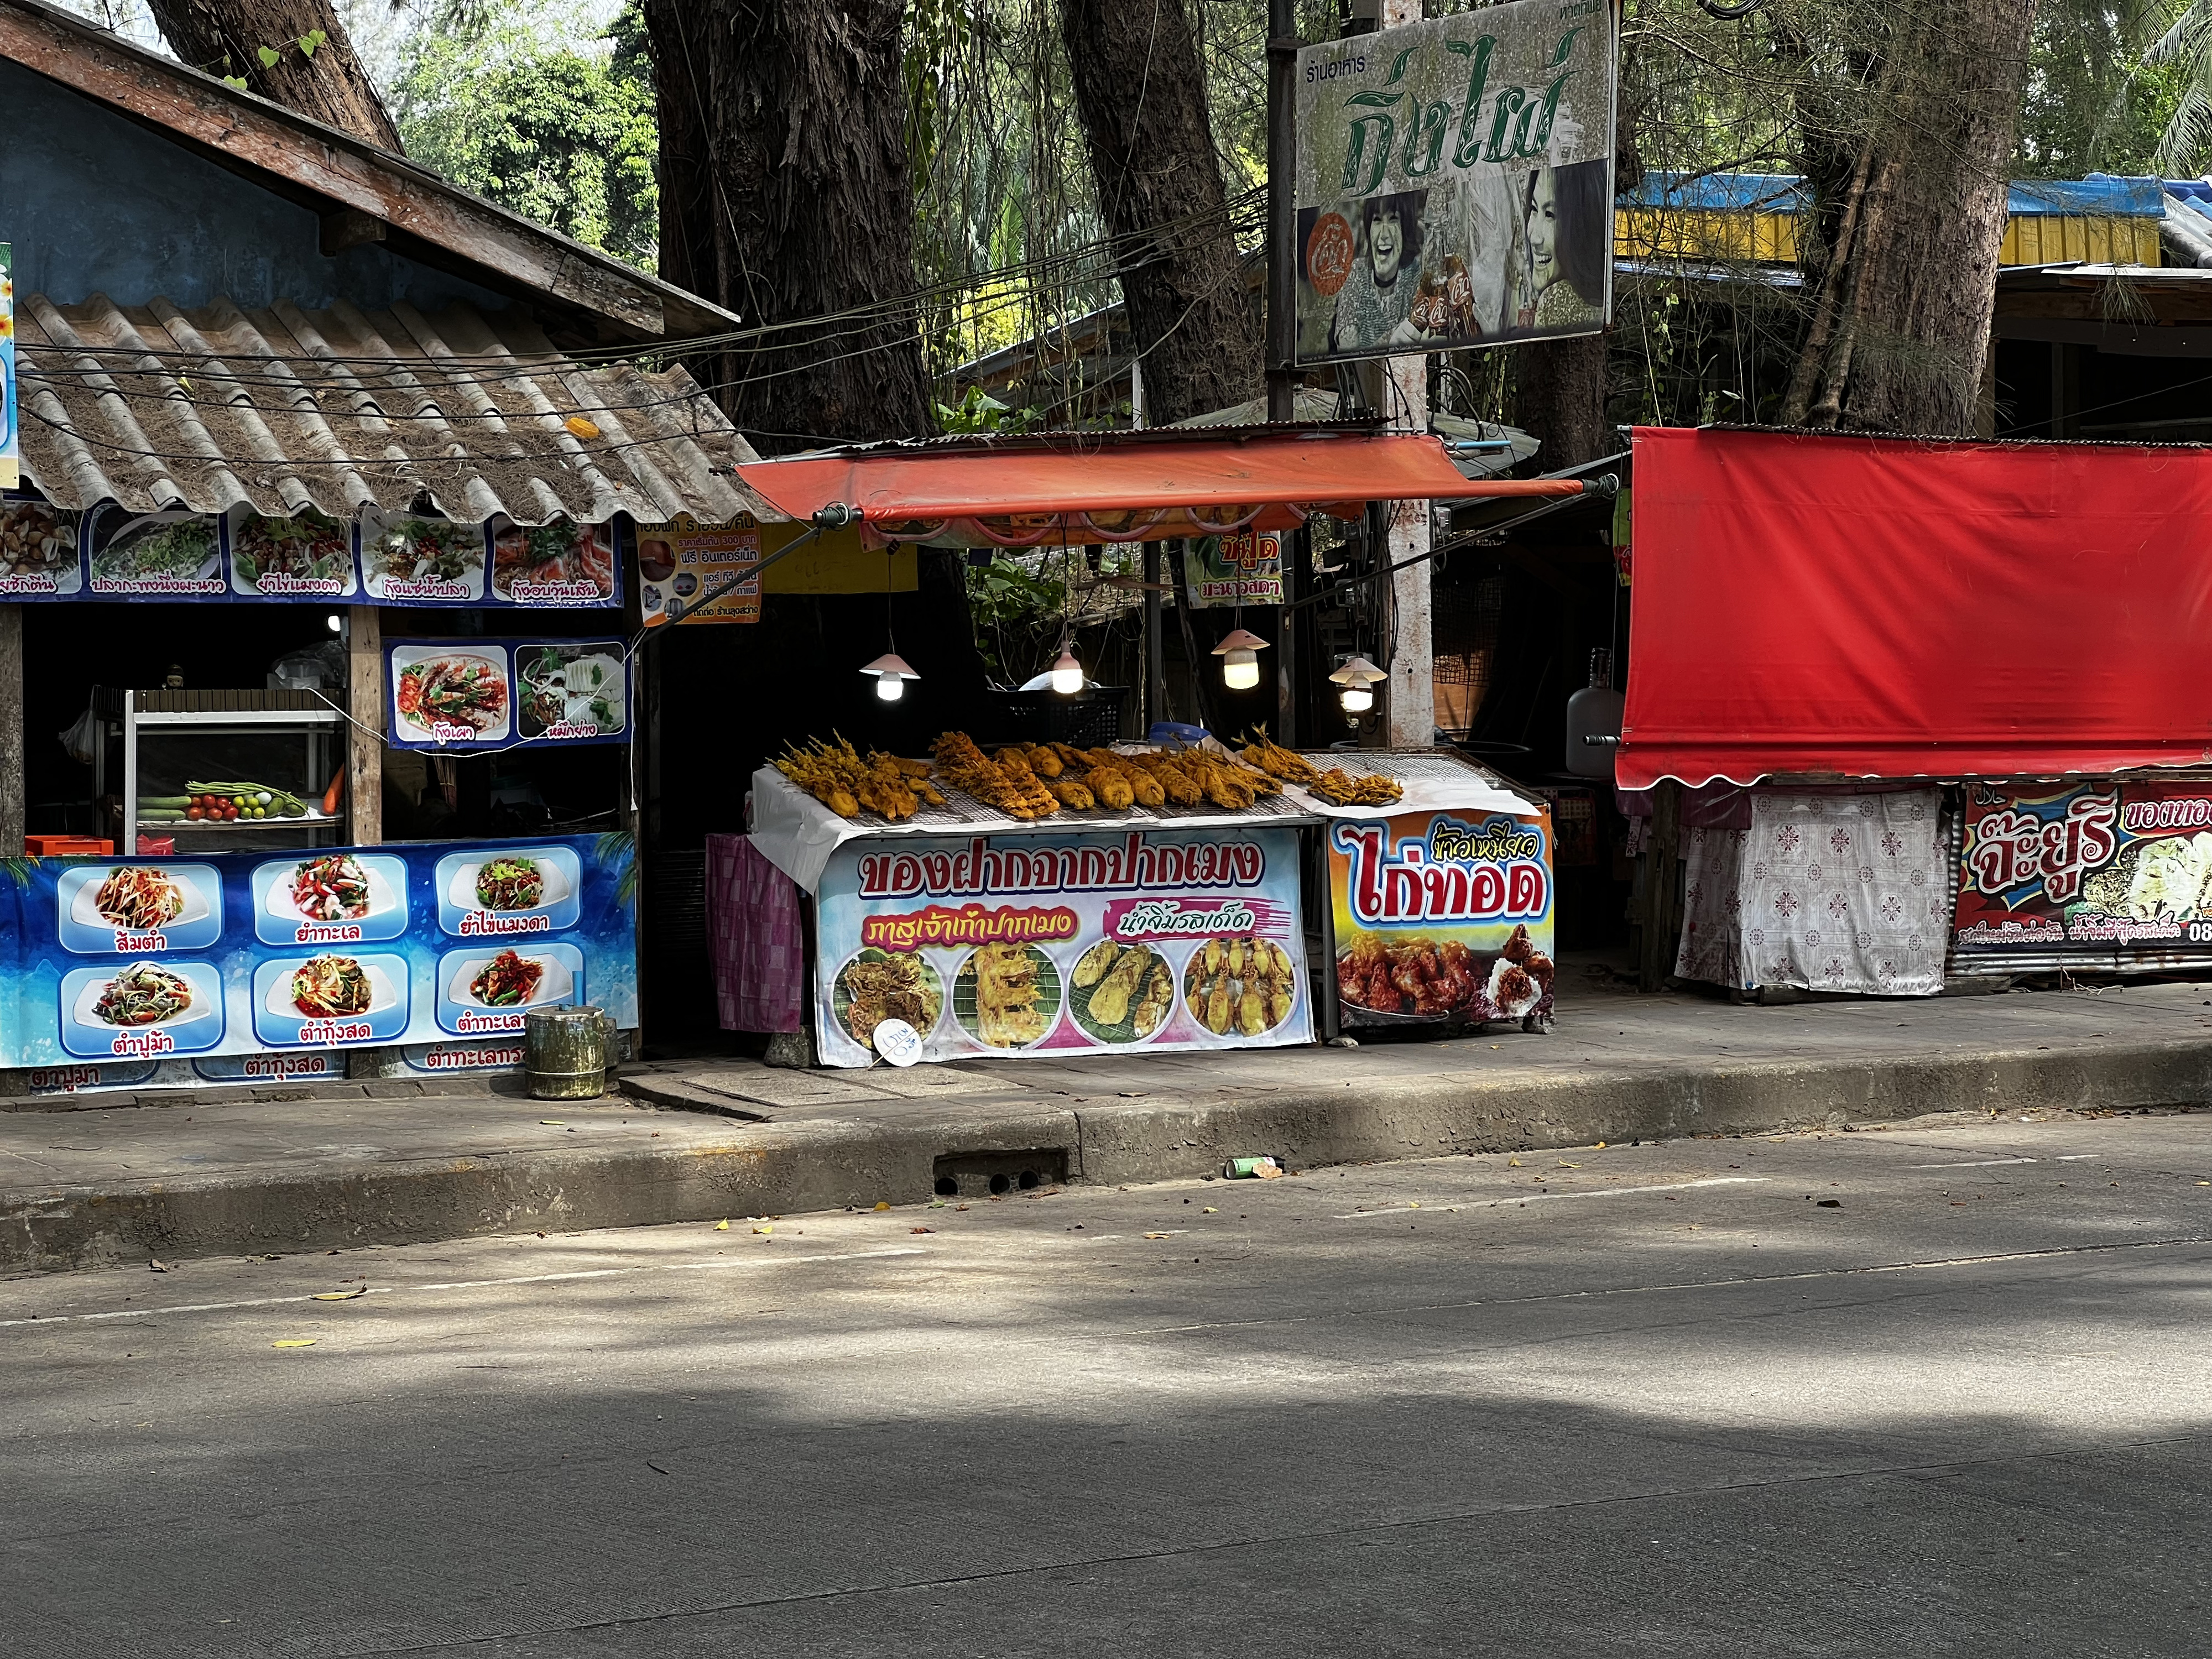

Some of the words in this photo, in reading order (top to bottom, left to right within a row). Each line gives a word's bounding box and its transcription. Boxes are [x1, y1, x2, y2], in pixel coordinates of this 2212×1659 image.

[1306, 55, 1365, 84] ร้านอาหาร
[679, 535, 719, 546] ราคาเริ่มต้น
[722, 536, 738, 545] 300
[742, 535, 756, 543] บาท
[681, 551, 697, 563] ฟรี
[701, 547, 757, 562] อินเตอร์เน็ต
[92, 571, 224, 591] ปลากะพงนึ่งมะนาว
[258, 574, 339, 591] ยำไข่แมงดา
[704, 572, 719, 582] แอร์
[723, 571, 734, 581] ทีวี
[384, 576, 467, 598] กุ้งแช่น้ำปลา
[513, 581, 597, 599] กุ้งอบวุ้นเส้น
[737, 585, 757, 594] กาแฟ
[717, 605, 758, 617] ร้านลุงสว่าง
[435, 723, 473, 742] กุ้งเผา
[548, 722, 596, 737] หมึกย่าง
[1976, 786, 2006, 805] حلال
[2126, 801, 2212, 827] ของทอ
[1433, 822, 1538, 861] ข้าวเหนียว
[860, 833, 1260, 894] ของฝากจากปากเมง
[1342, 831, 1543, 916] ไก่ทอด
[460, 911, 549, 935] ยำไข่แมงดา
[1120, 902, 1252, 932] น้ำจิ้มรสเด็ด
[116, 931, 165, 951] ส้มตำ
[298, 922, 359, 941] ยำทะเล
[300, 1021, 371, 1045] ตำกุ้งสด
[113, 1031, 173, 1057] ตำปูม้า
